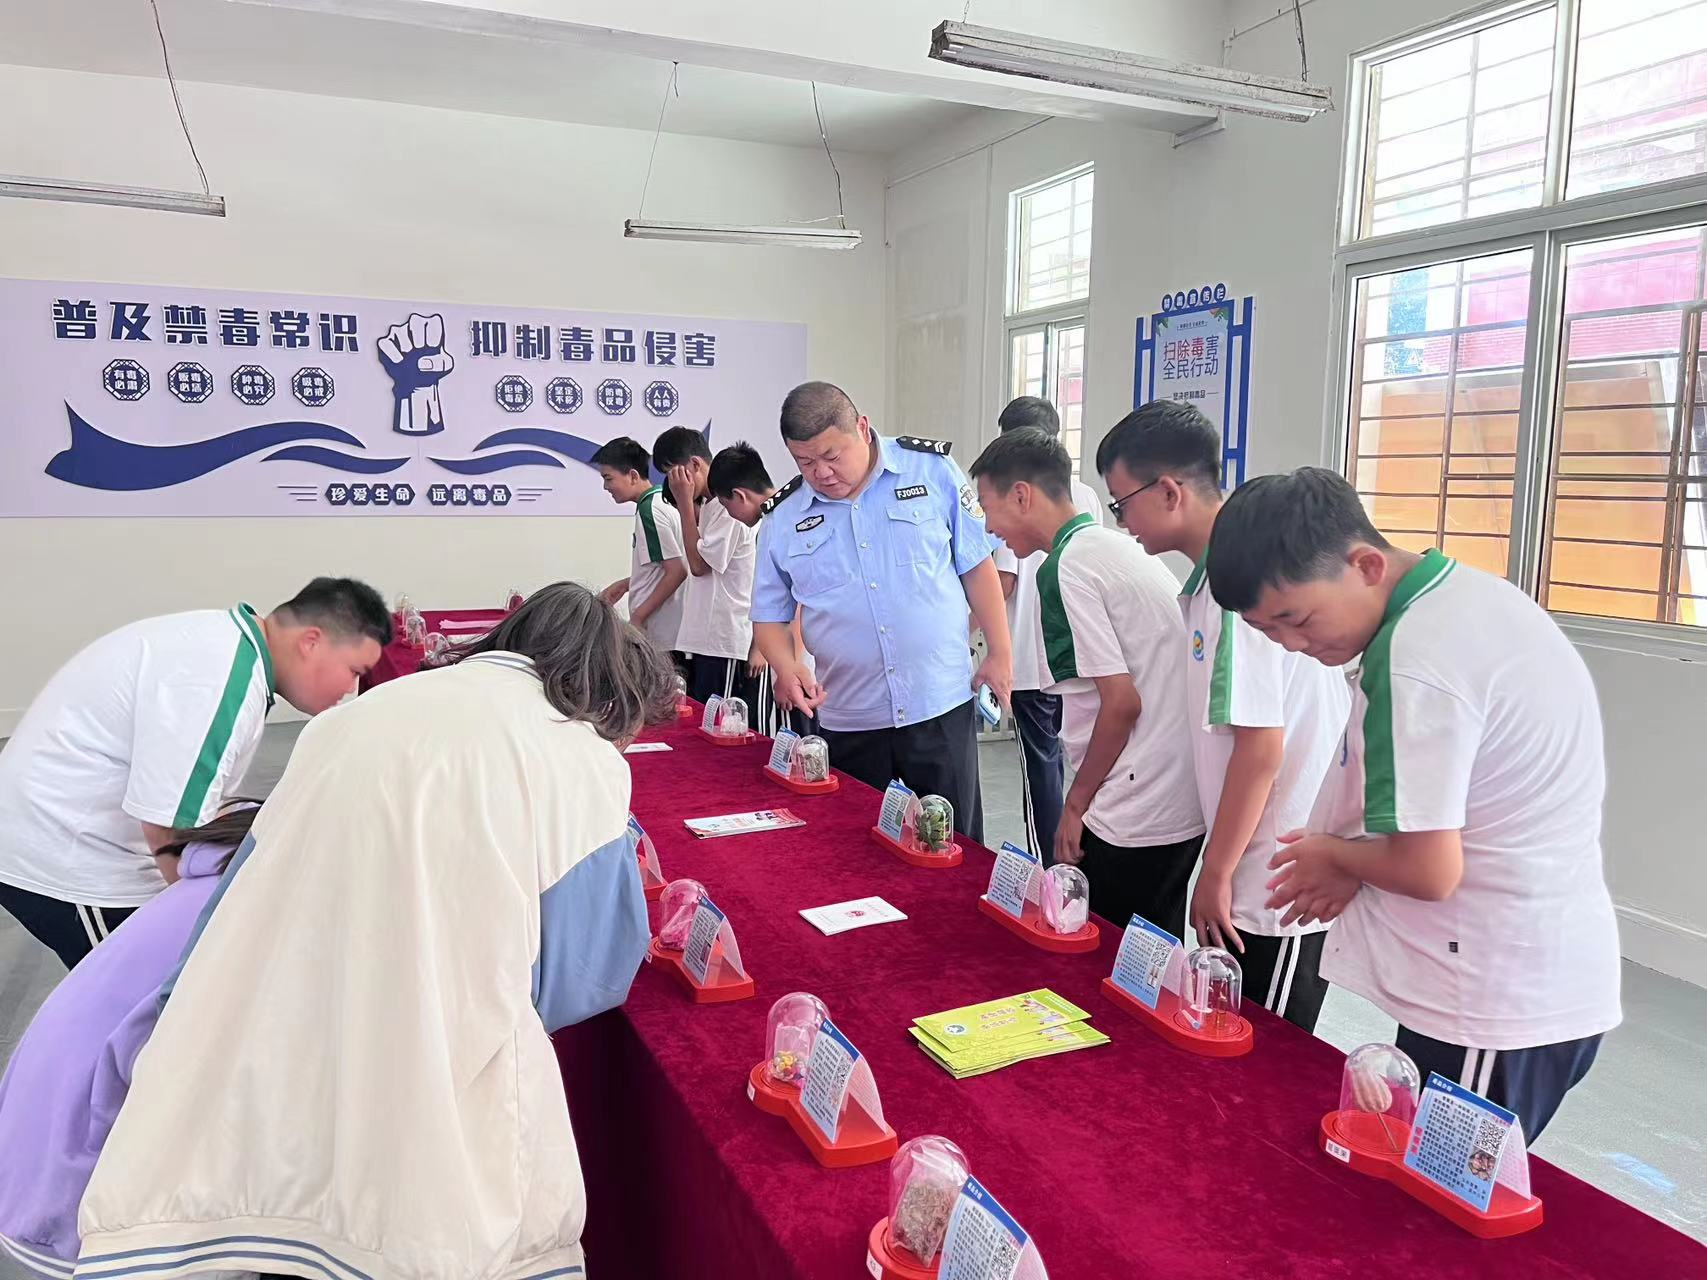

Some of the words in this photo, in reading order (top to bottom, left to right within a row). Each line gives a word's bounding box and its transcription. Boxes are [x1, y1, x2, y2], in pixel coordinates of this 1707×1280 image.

[52, 299, 359, 352] 普及禁毒常识
[470, 319, 718, 367] 抑制毒品侵害
[1163, 334, 1219, 362] 扫除毒害
[1163, 355, 1219, 380] 全民行动
[331, 486, 411, 502] 珍爱生命
[431, 487, 508, 502] 远离毒品
[896, 486, 925, 499] FJ0013
